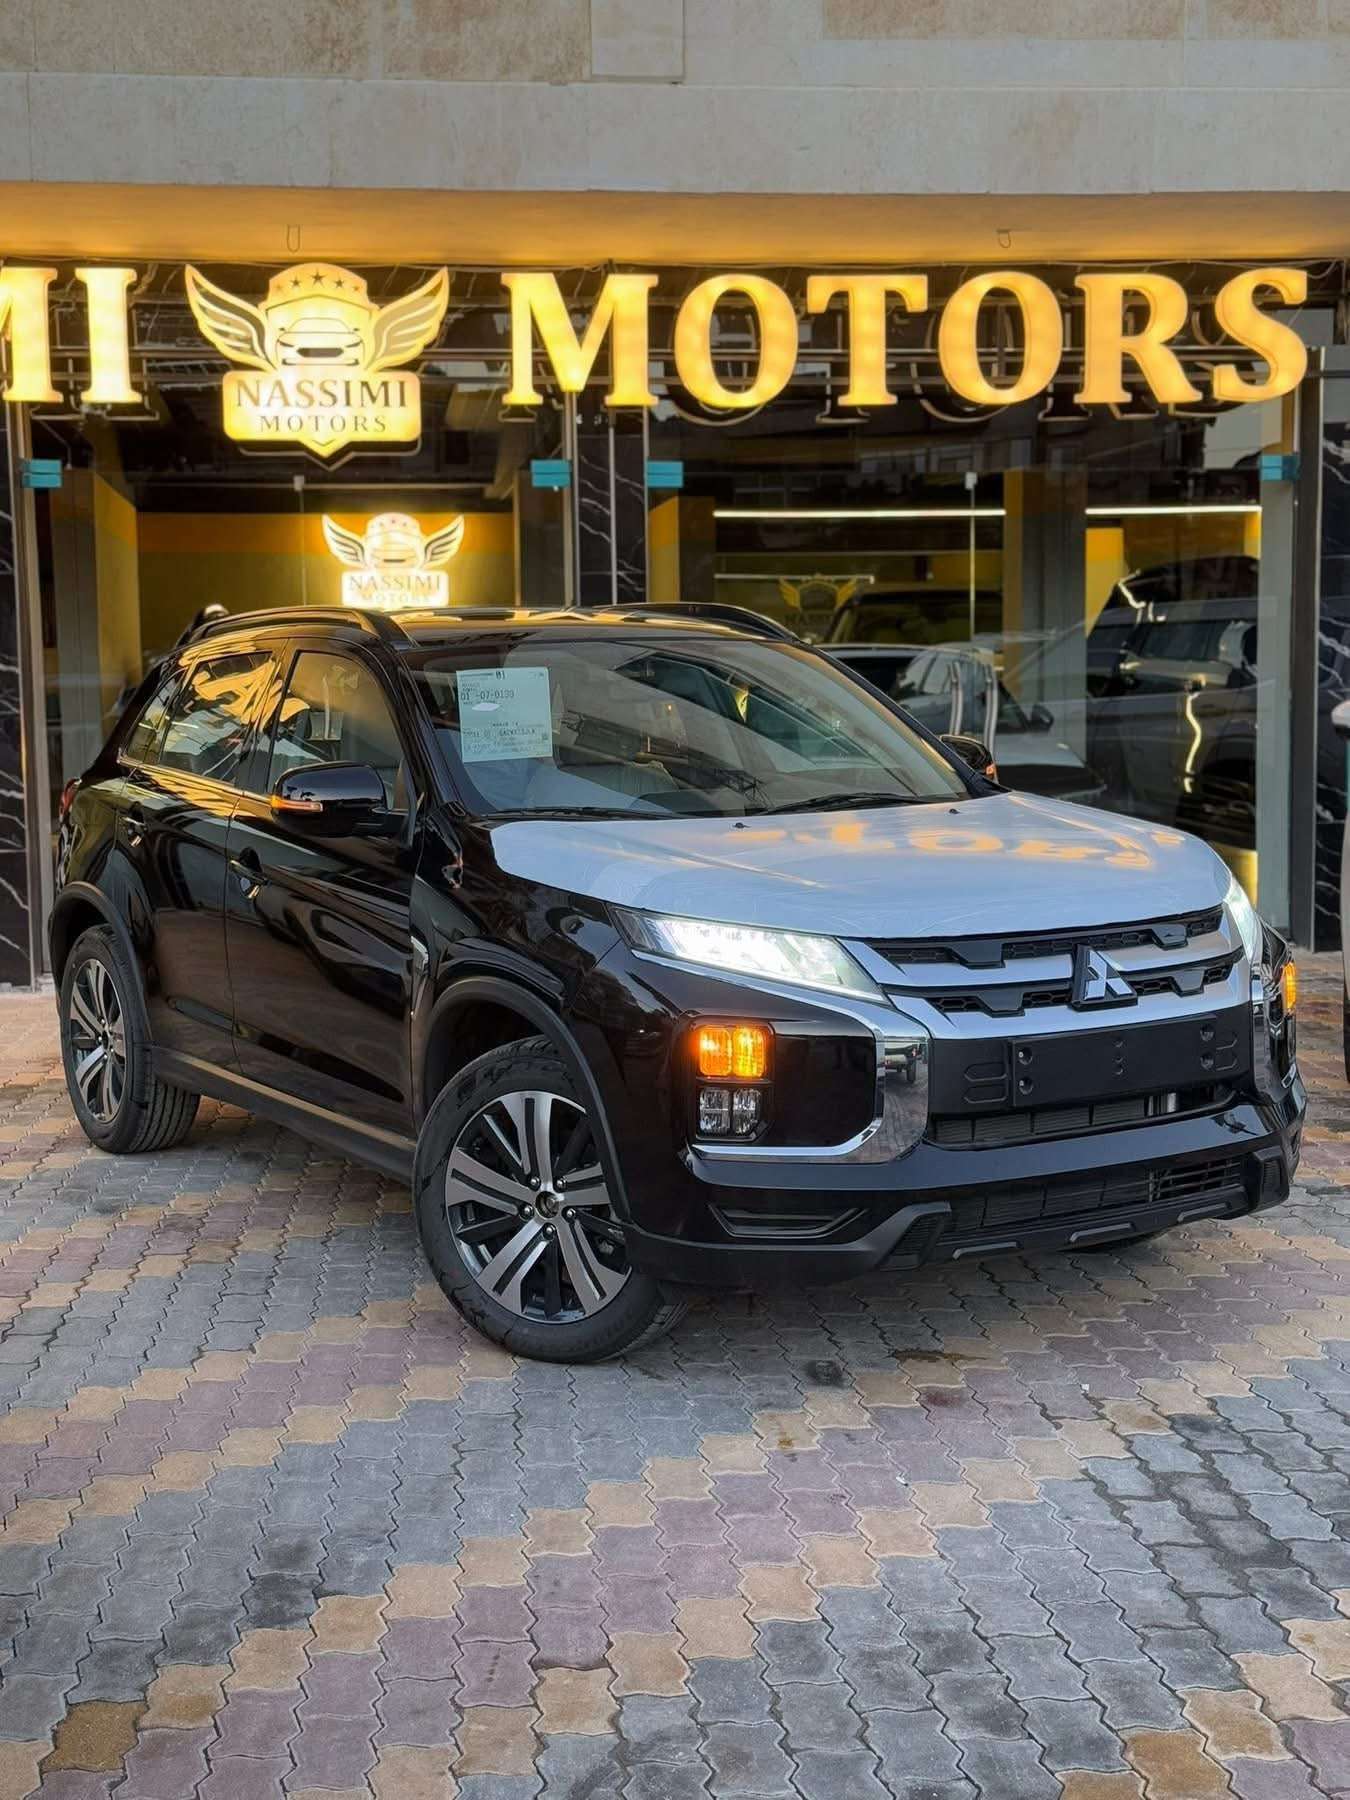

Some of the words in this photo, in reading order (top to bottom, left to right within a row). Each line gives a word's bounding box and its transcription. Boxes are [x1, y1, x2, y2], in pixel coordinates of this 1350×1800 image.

[501, 268, 1308, 409] MOTORS
[236, 379, 407, 408] NASSIMI
[260, 415, 386, 432] MOTORS
[349, 575, 440, 591] NASSIMI
